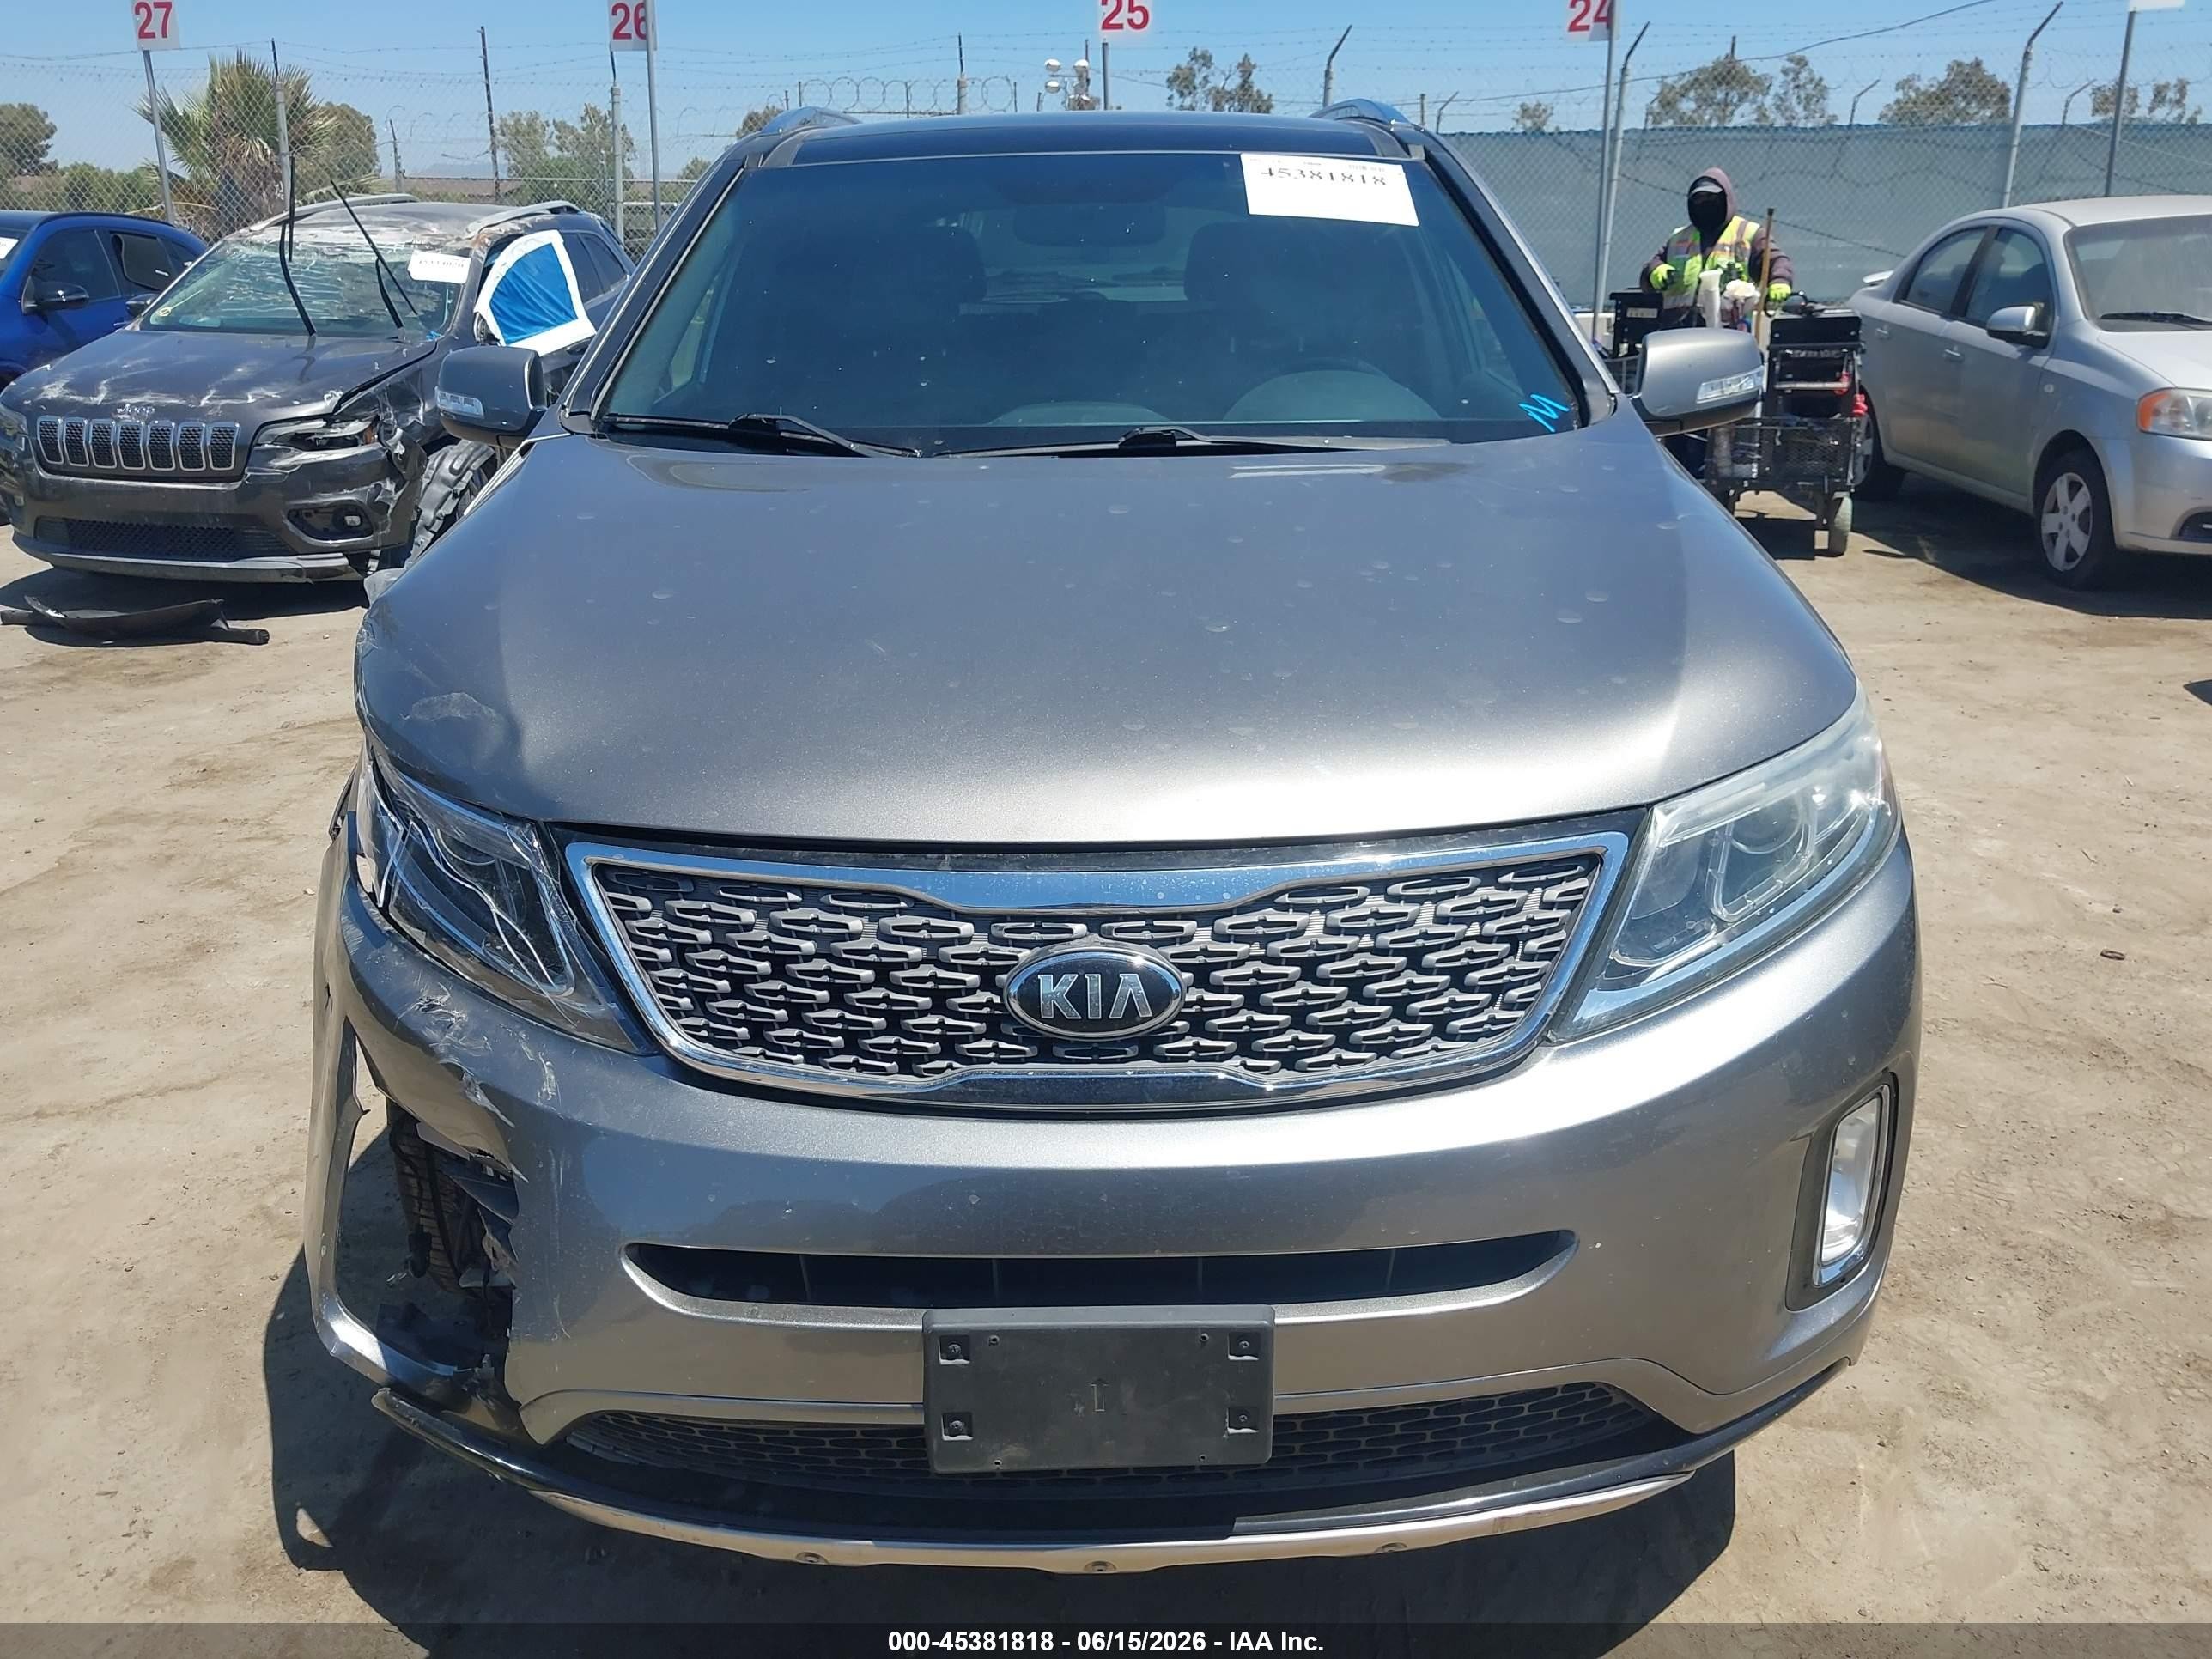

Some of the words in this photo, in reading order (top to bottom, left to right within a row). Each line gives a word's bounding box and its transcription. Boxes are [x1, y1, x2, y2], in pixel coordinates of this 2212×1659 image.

[134, 2, 173, 39] 27
[611, 2, 647, 40] 26
[1101, 0, 1149, 30] 25
[1568, 0, 1613, 32] 24
[1261, 167, 1387, 186] 45381818
[1037, 973, 1153, 1019] KIA
